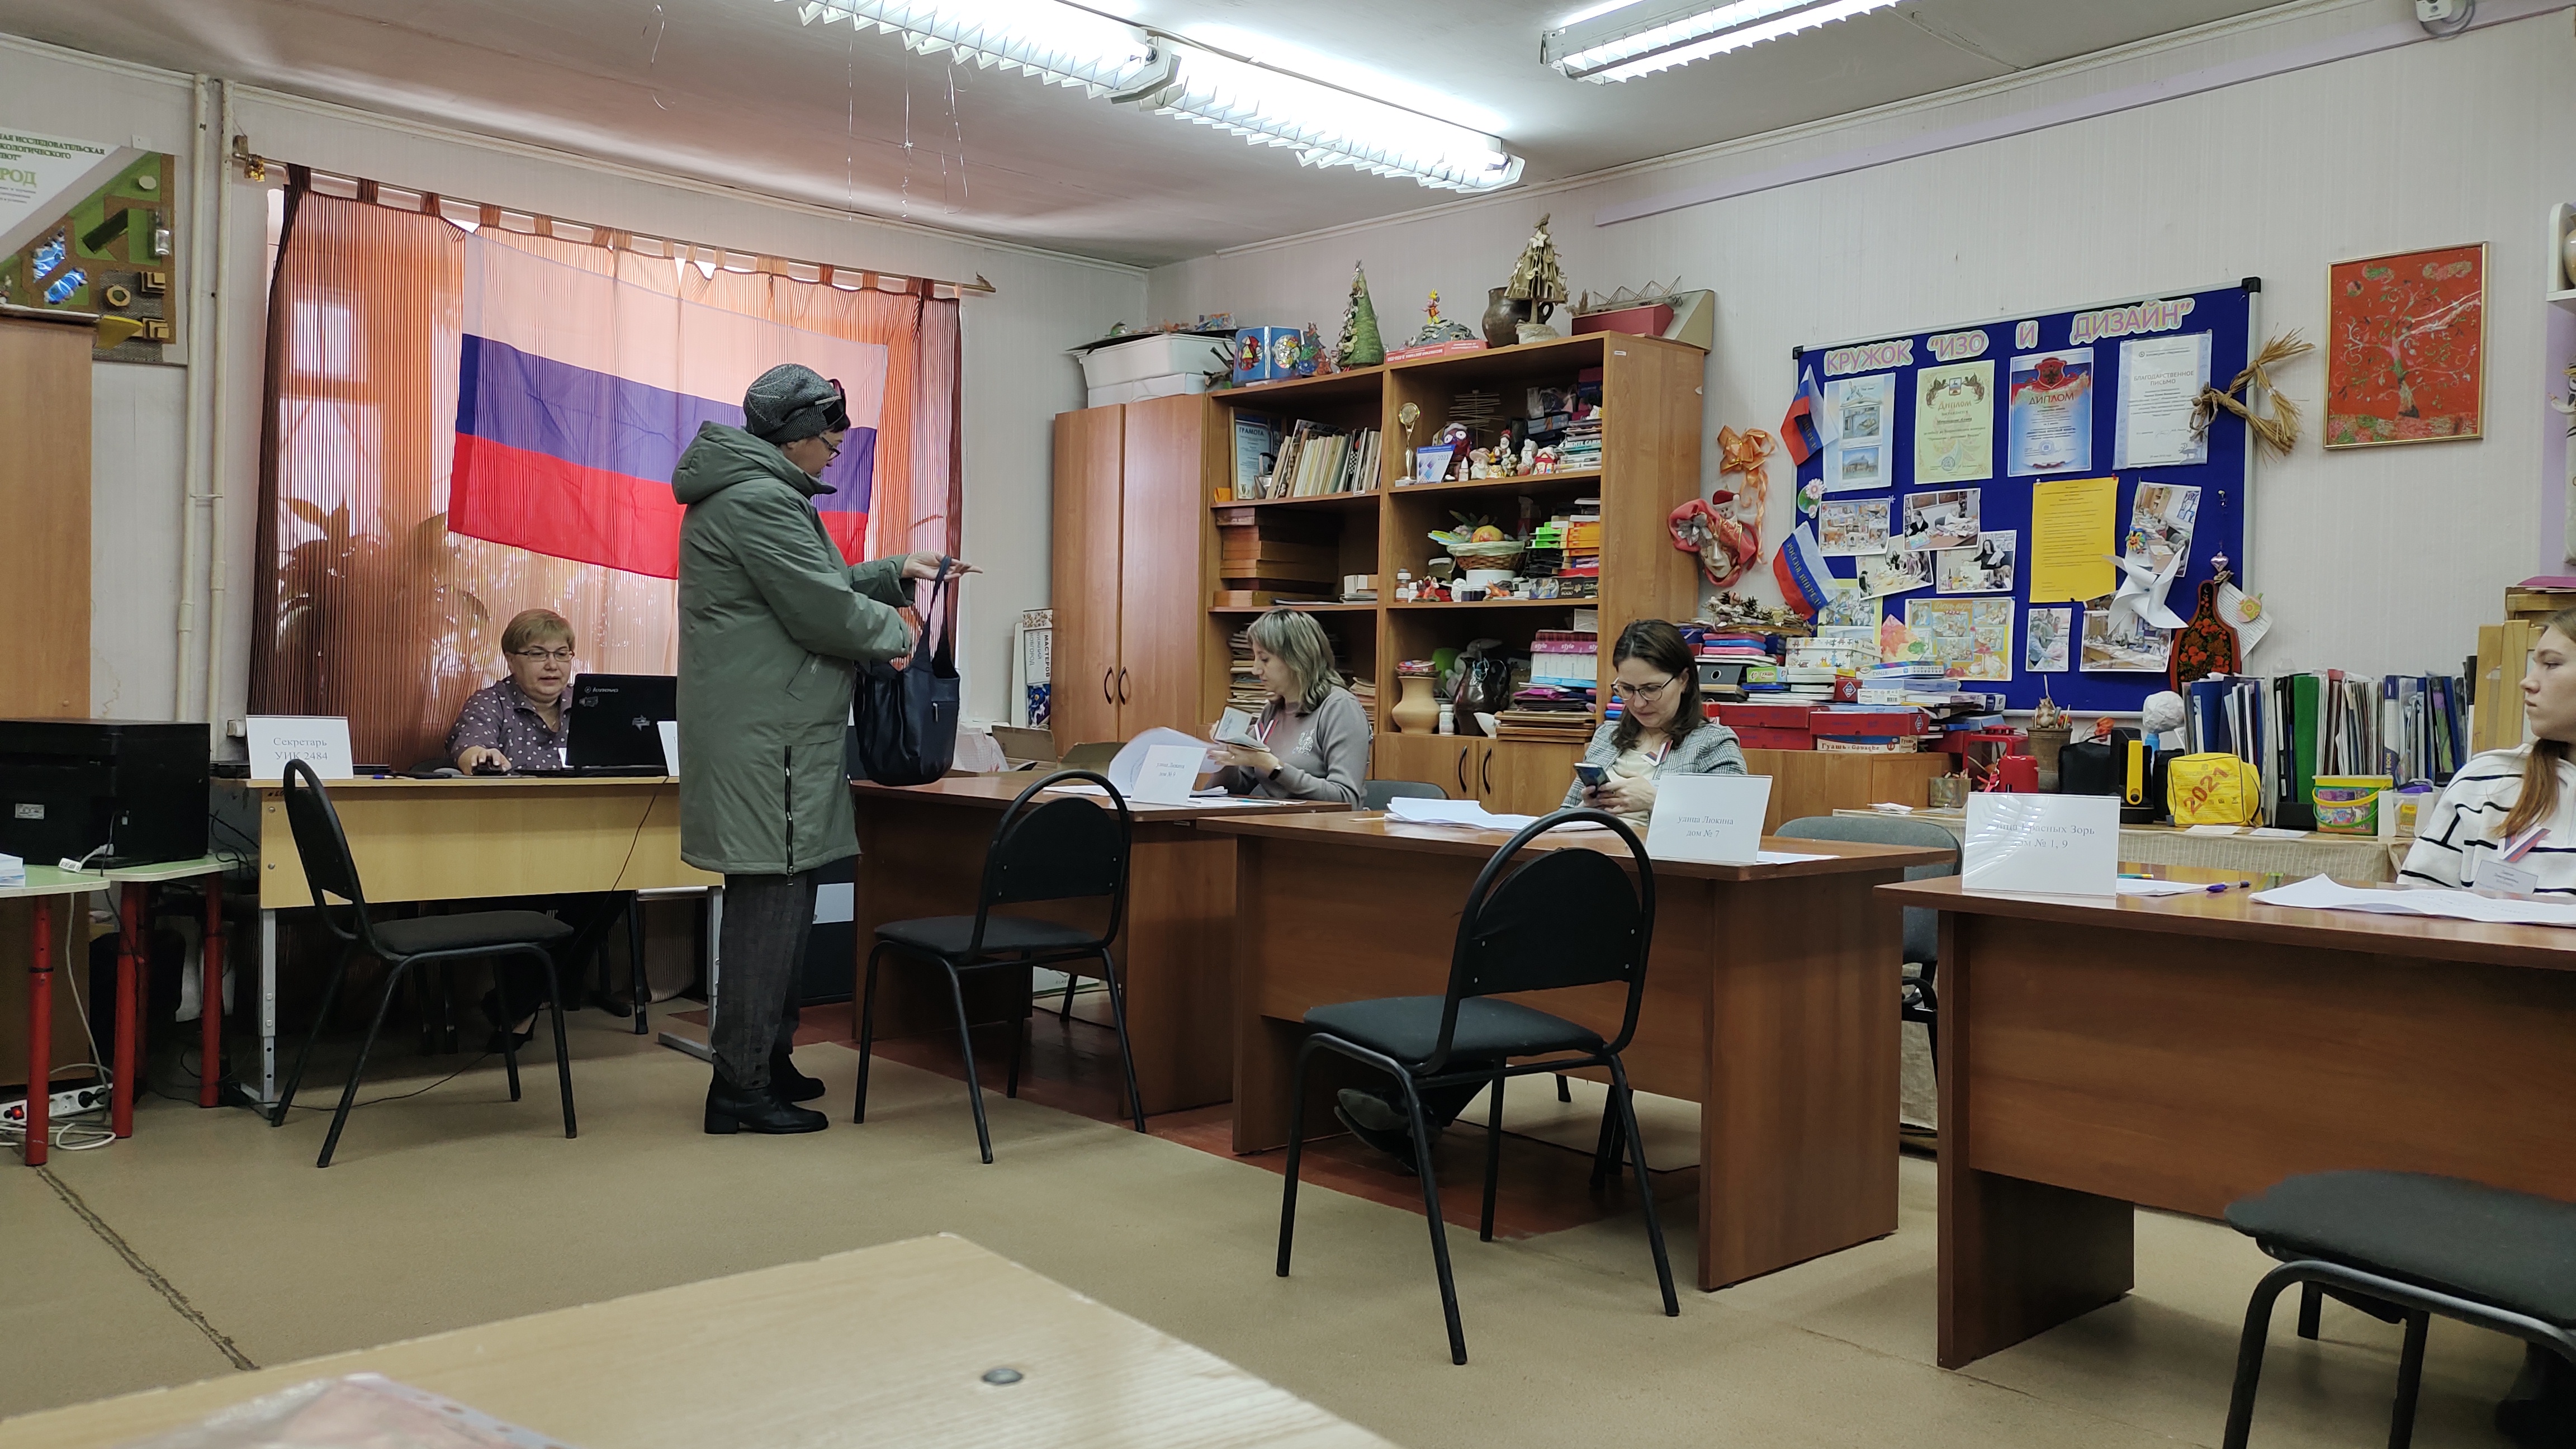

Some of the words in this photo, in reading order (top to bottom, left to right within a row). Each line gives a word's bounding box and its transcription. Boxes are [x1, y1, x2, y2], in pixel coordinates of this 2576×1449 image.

[16, 136, 105, 155] ИССЛЕДОВАТЕЛЬСКАЯ
[1826, 340, 1911, 373] КРУЖОК
[2019, 322, 2035, 345] И
[2134, 370, 2195, 381] БЛАГОДАРСТВЕННОЕ
[2028, 392, 2075, 405] ДИПЛОМ
[1239, 427, 1264, 435] ГРАМОТА
[273, 737, 327, 748] Секретарь
[274, 751, 300, 760] УИК
[304, 751, 328, 760] 2484
[2183, 766, 2229, 816] 2021
[1702, 816, 1734, 825] Люкина
[1703, 829, 1713, 837] №
[2071, 825, 2095, 836] Зорь
[2034, 839, 2047, 847] №
[2062, 840, 2068, 848] 9
